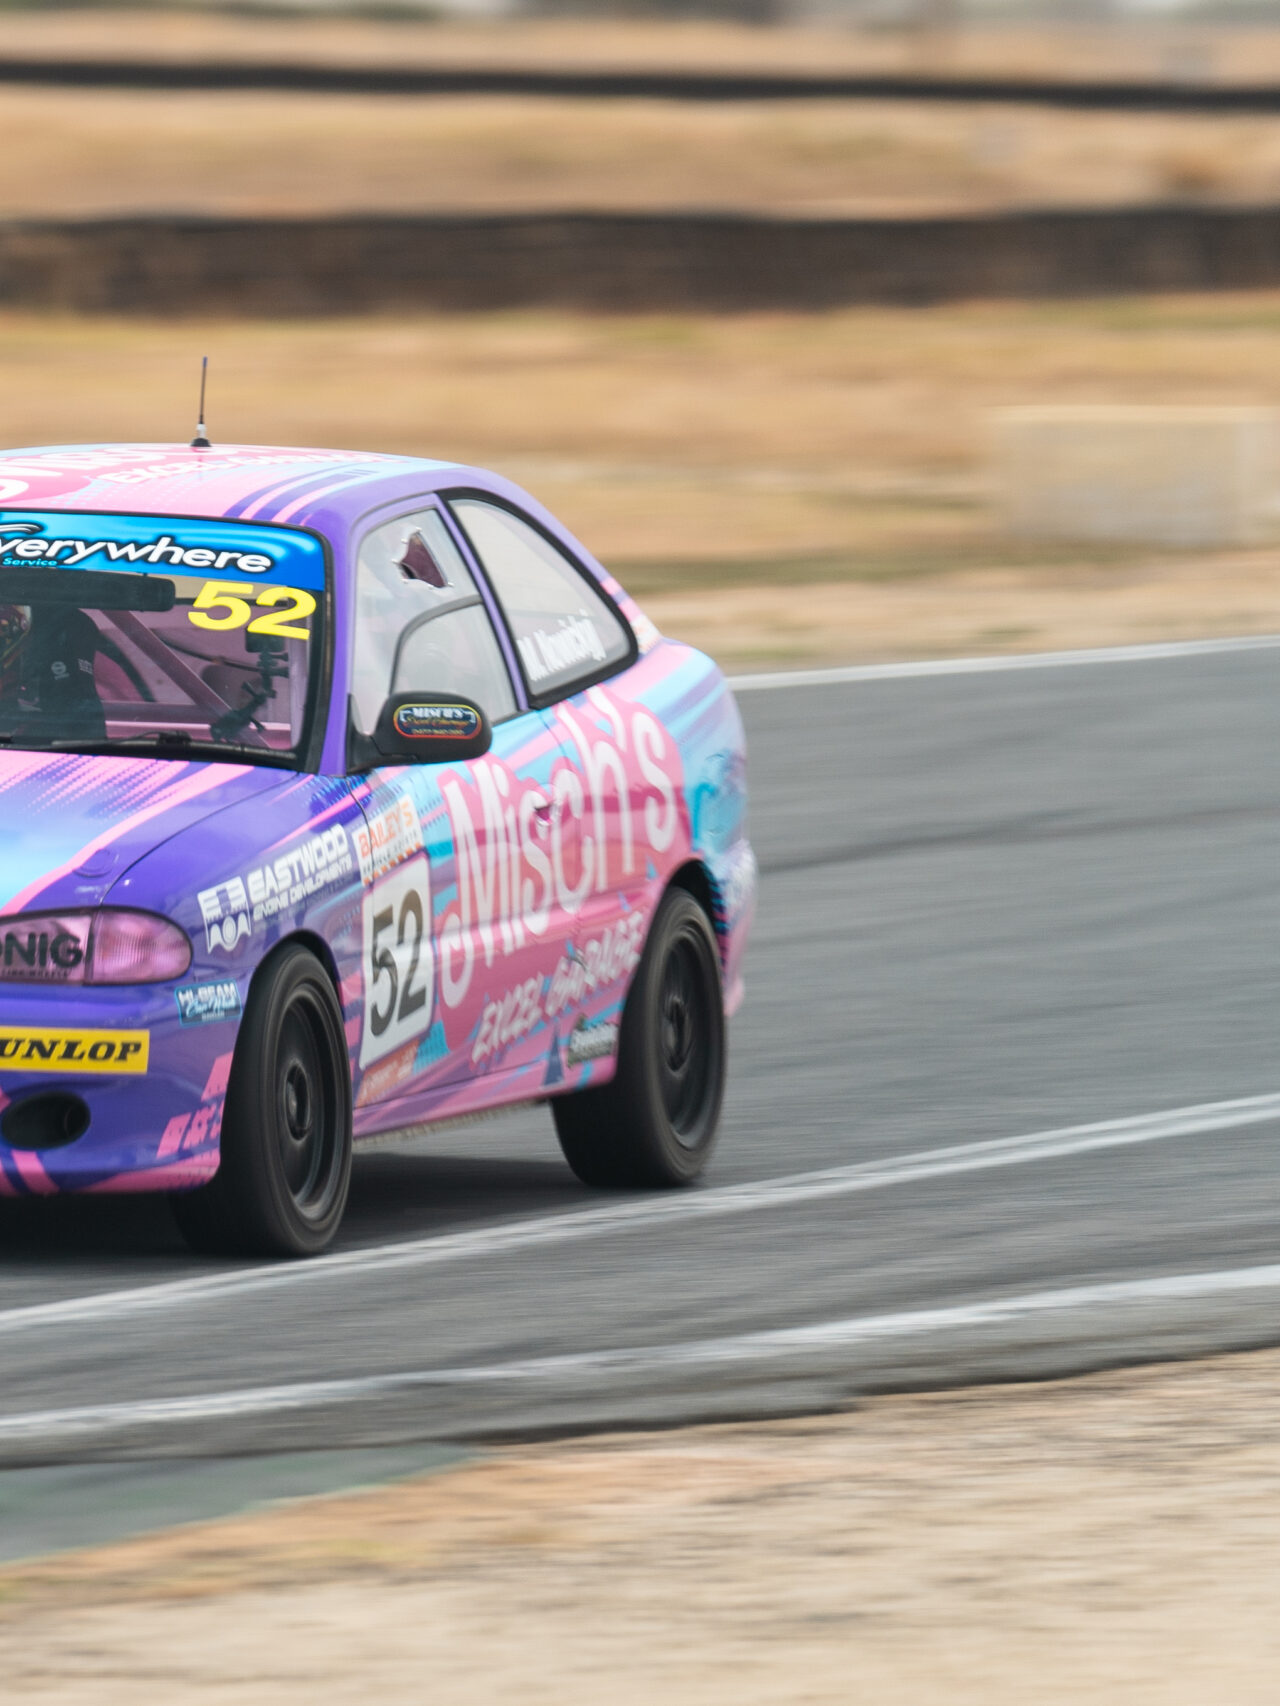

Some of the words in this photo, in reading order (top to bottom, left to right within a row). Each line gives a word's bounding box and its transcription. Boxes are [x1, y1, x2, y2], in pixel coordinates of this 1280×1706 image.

[3, 557, 58, 567] Service
[187, 580, 317, 640] 52
[247, 823, 349, 905] EASTWOOD
[440, 685, 679, 1009] Misch's
[370, 888, 427, 1037] 52
